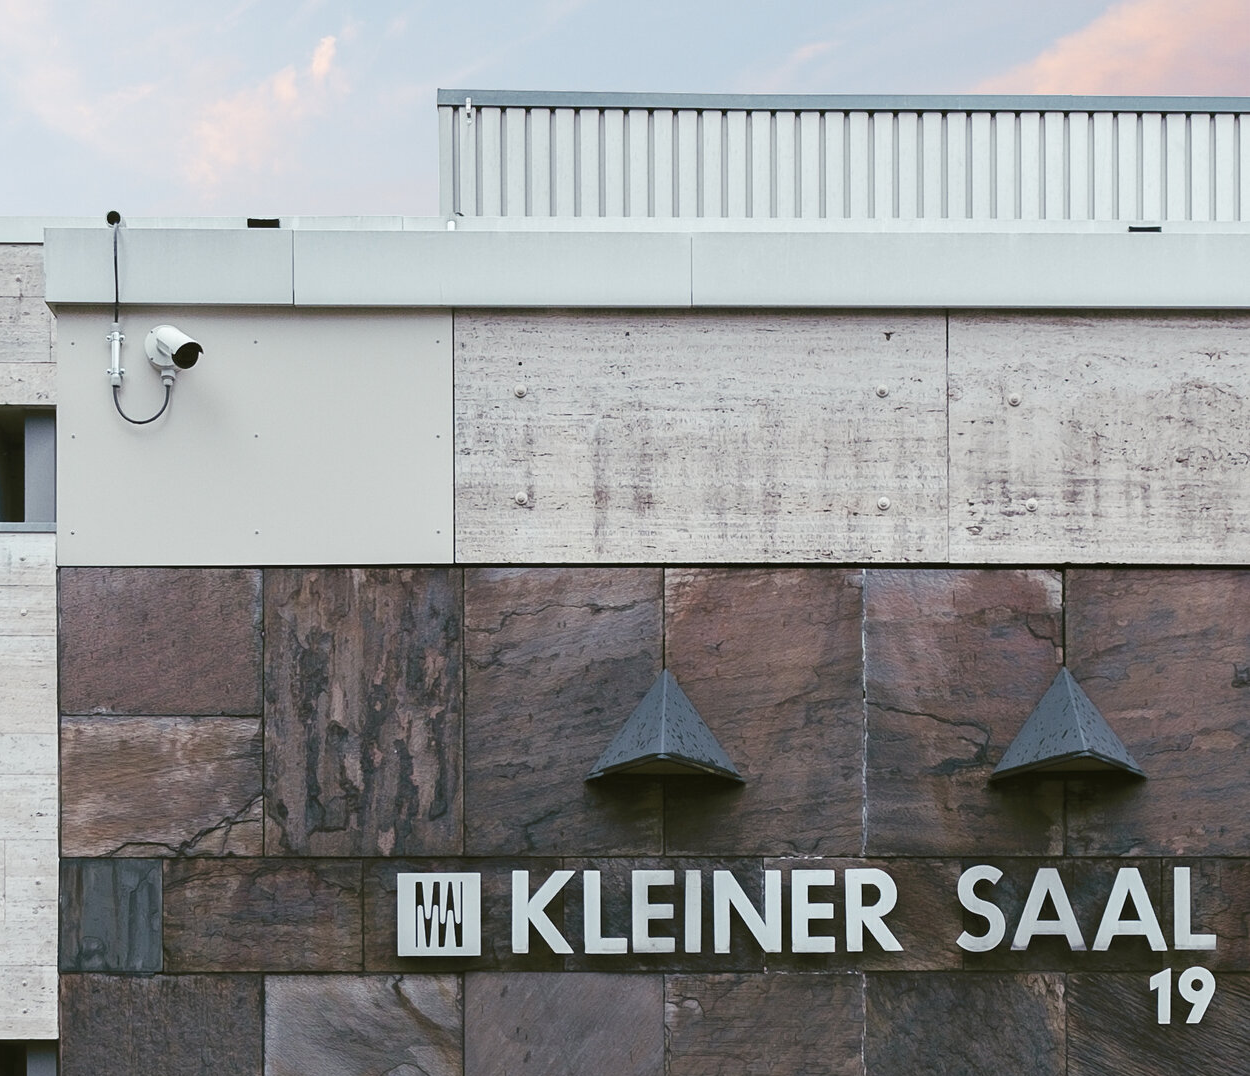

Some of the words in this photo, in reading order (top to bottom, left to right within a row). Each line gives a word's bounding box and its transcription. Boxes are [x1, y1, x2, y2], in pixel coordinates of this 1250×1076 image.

[511, 867, 904, 954] KLEINER
[955, 864, 1218, 952] SAAL
[1149, 966, 1216, 1025] 19
